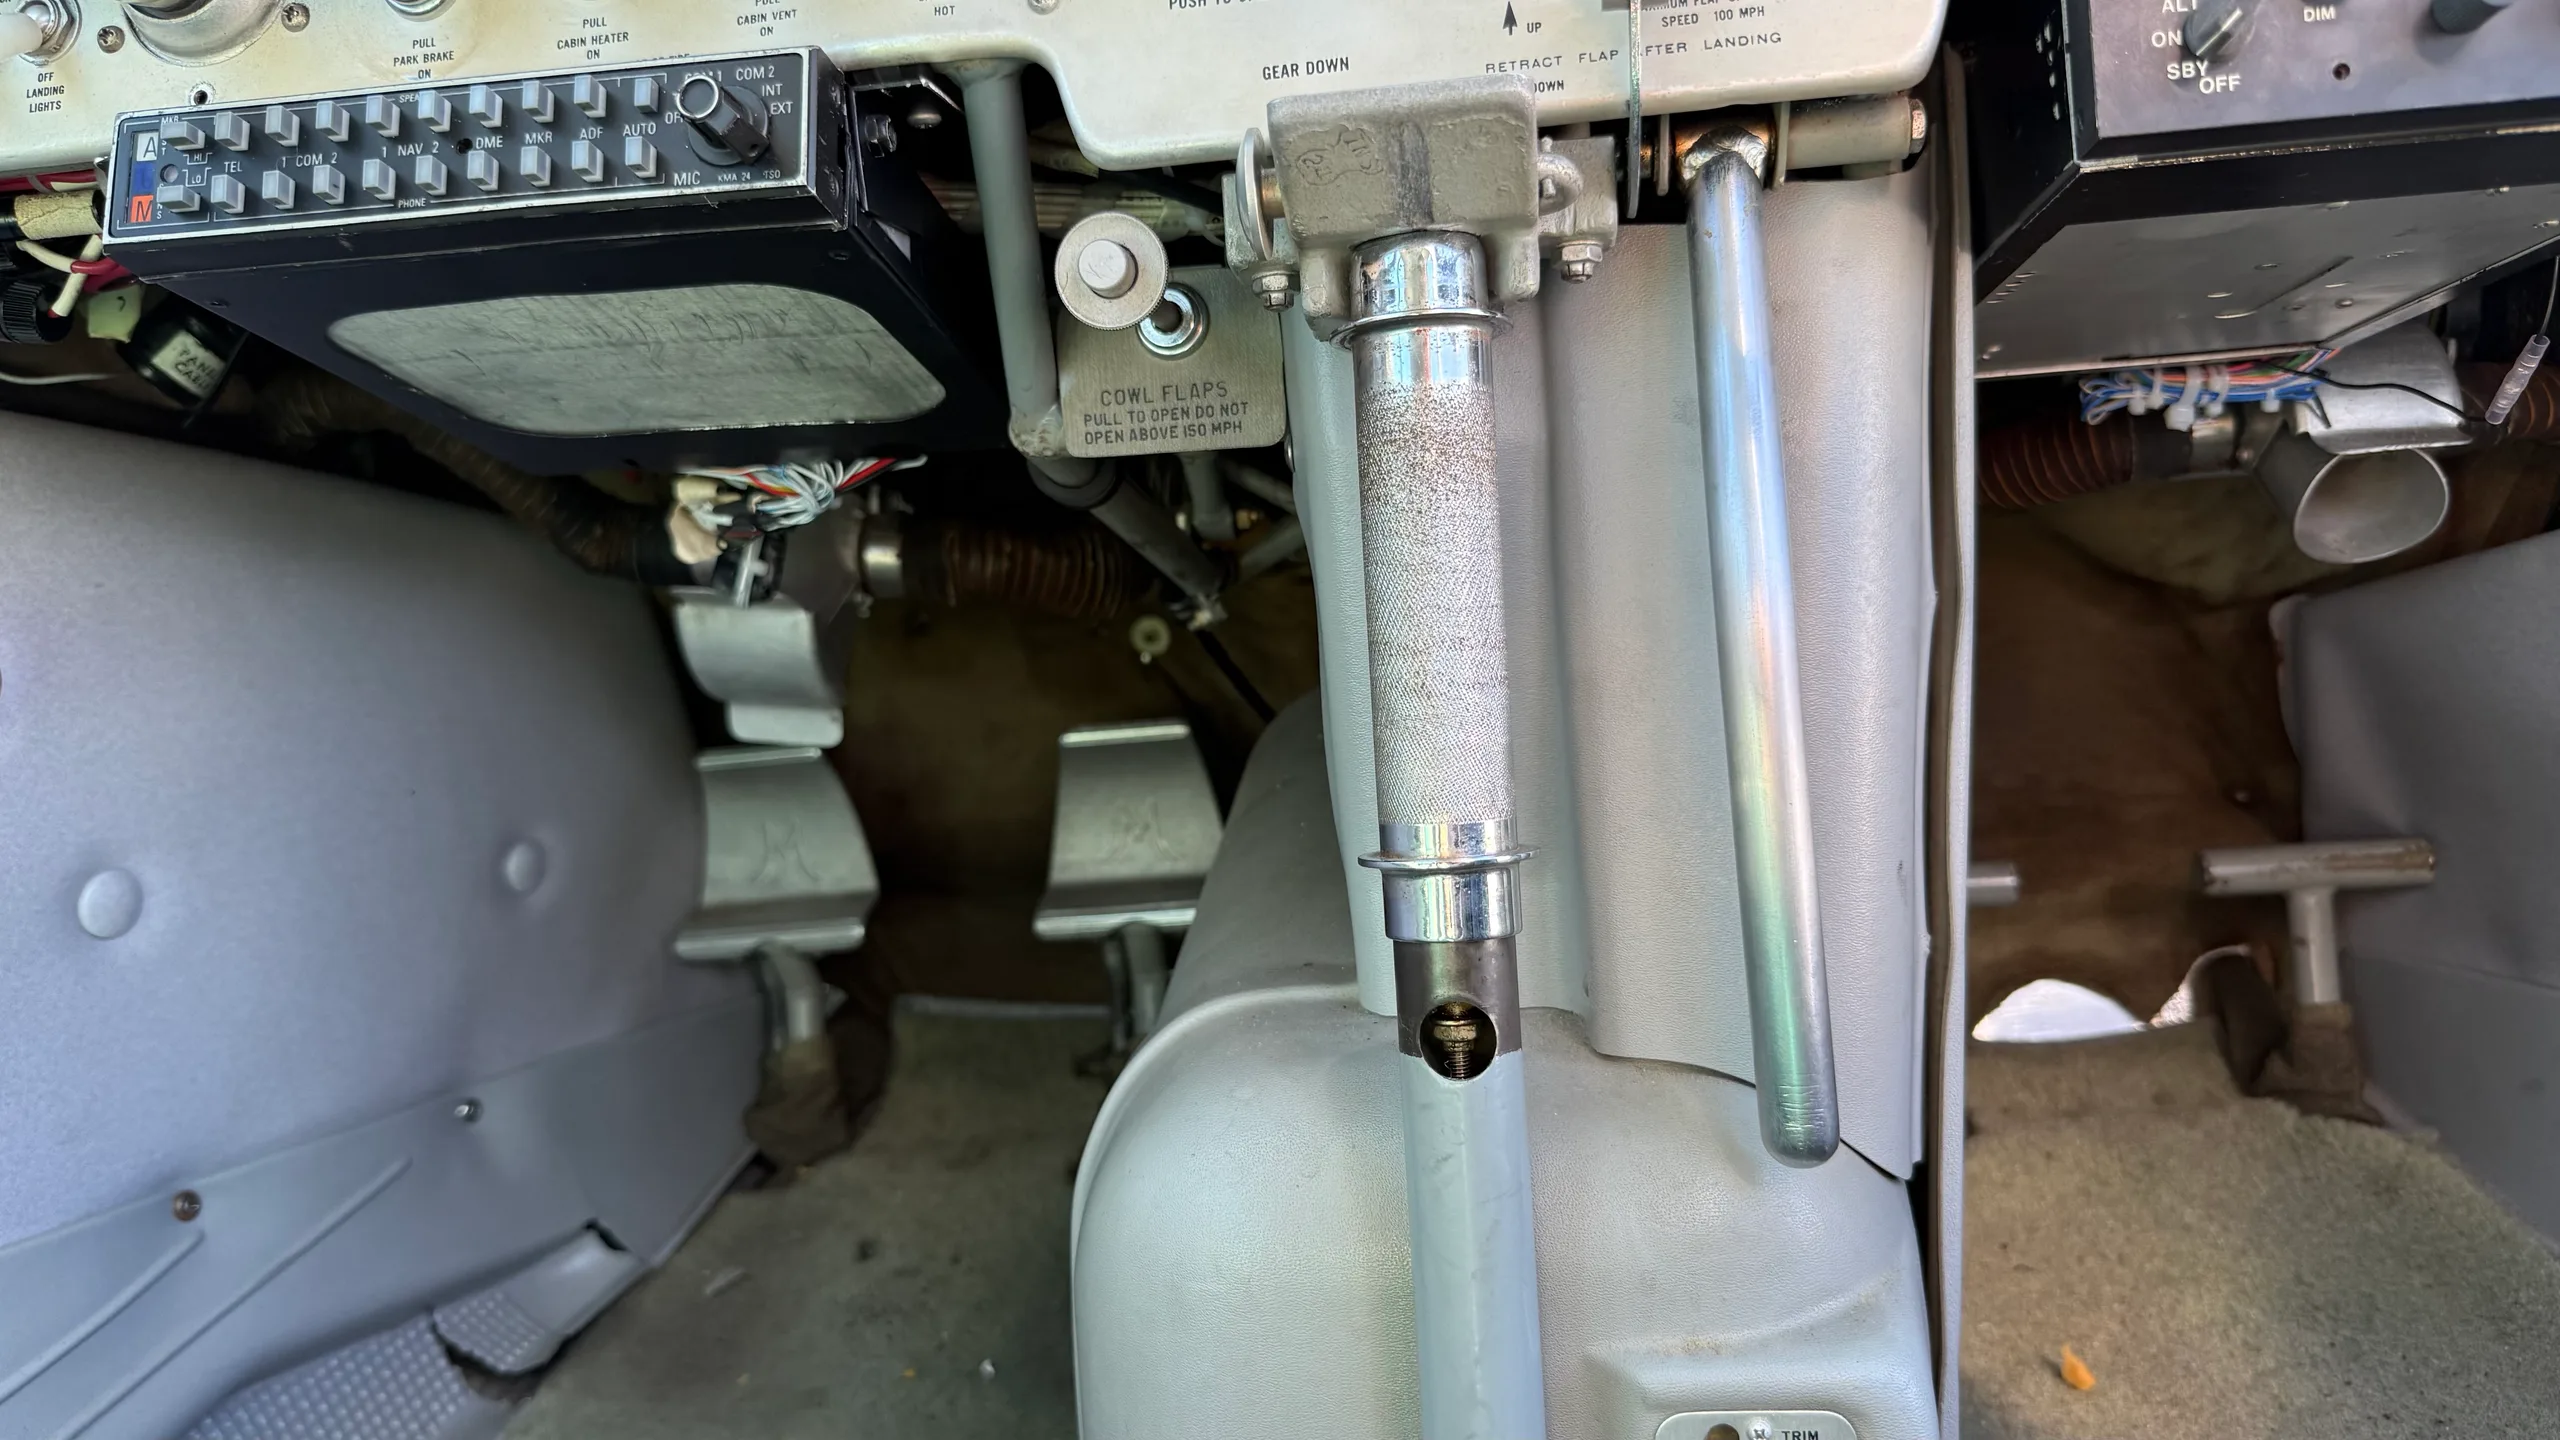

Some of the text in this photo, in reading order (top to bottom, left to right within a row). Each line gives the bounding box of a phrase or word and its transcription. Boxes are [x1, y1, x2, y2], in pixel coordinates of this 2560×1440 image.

[737, 9, 797, 26] CABIN VENT
[934, 6, 956, 16] HOT
[1662, 6, 1764, 27] SPEED 100 MPH
[2304, 6, 2336, 22] DIM
[582, 17, 608, 28] PULL
[1526, 22, 1542, 34] UP
[760, 26, 774, 36] ON
[412, 38, 436, 49] PULL
[557, 32, 629, 50] CABIN HEATER
[2152, 30, 2182, 48] ON
[394, 50, 454, 67] PARK BRAKE
[586, 50, 600, 60] ON
[1486, 32, 1782, 74] RETRACT FLAP FTER LANDING
[418, 69, 431, 79] ON
[736, 66, 775, 80] COM 2
[1262, 57, 1350, 80] GEAR DOWN
[2166, 60, 2208, 80] SBY
[38, 72, 54, 82] OFF
[762, 84, 783, 96] INT
[1534, 80, 1564, 92] OWN
[2200, 74, 2241, 94] OFF
[26, 85, 64, 98] LANDING
[29, 100, 62, 113] LIGHTS
[770, 102, 793, 114] EXT
[580, 128, 604, 140] ADF
[622, 122, 656, 136] AUTO
[476, 136, 503, 150] DME
[525, 132, 552, 145] MKR
[143, 137, 157, 158] A
[382, 142, 439, 158] 1 NAV 2
[194, 153, 202, 162] HI
[282, 152, 338, 168] 1 COM 2
[224, 162, 242, 172] TEL
[191, 174, 202, 184] LO
[674, 171, 700, 186] MIC
[718, 172, 750, 182] KMA 24
[398, 198, 426, 208] PHONE
[136, 200, 152, 222] M
[1101, 381, 1228, 406] COWL FLAPS
[1084, 402, 1248, 427] PULL TO OPEN DO NOT
[1085, 420, 1242, 445] OPEN ABOVE 150 MPH
[1782, 1431, 1818, 1440] TRIM
